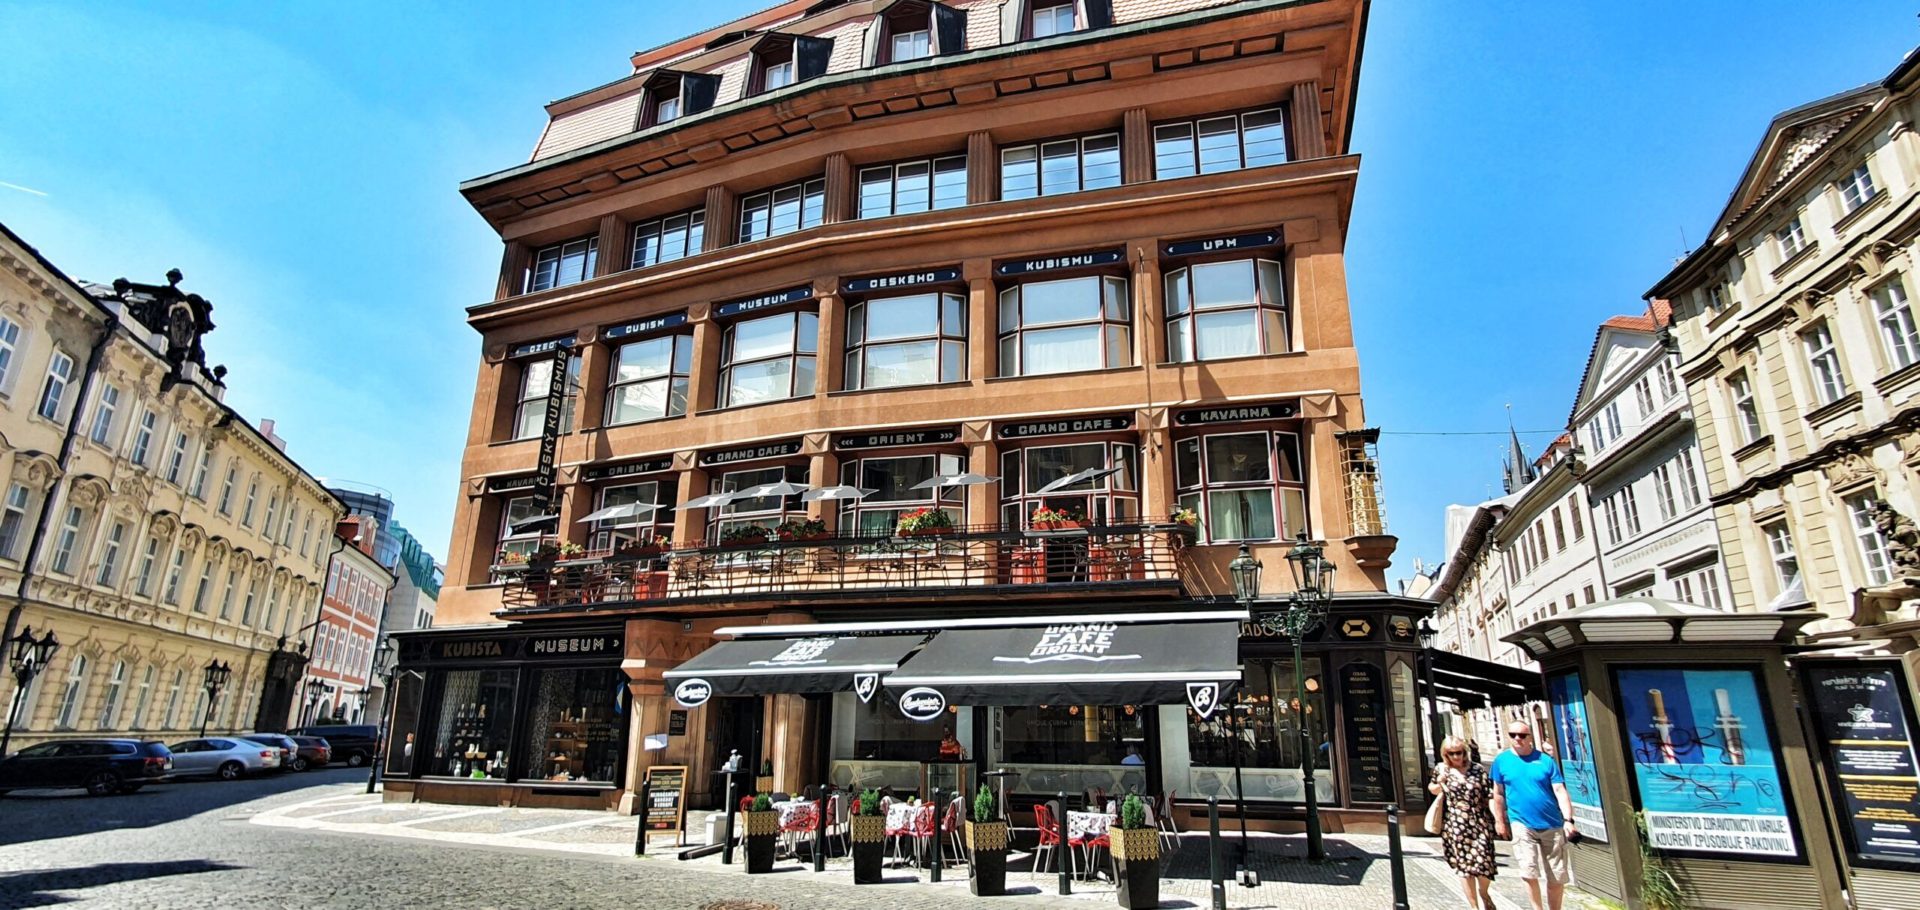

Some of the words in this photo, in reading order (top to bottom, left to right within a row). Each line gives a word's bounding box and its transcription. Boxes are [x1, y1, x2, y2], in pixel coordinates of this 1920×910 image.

[1202, 238, 1237, 250] UPM
[1026, 255, 1093, 271] KUBISMU
[738, 294, 788, 311] MUSEUM
[625, 319, 665, 334] CUBISM
[549, 350, 567, 429] KUBISMUS
[1200, 407, 1271, 421] KAVARNA
[1018, 422, 1067, 435] GRAND
[1073, 418, 1113, 432] CAFE
[868, 433, 925, 446] ORIENT
[717, 449, 754, 463] GRAND
[757, 445, 788, 459] CAFE
[608, 462, 651, 475] ORIENT
[534, 637, 605, 653] MUSEUM
[1036, 631, 1114, 647] CAFE
[443, 641, 502, 657] KUBISTA
[1030, 643, 1111, 656] ORIENT
[1651, 816, 1702, 830] MINISTERSTVO
[1703, 817, 1757, 833] ZDRAVOTNICTVÍ
[1655, 832, 1692, 847] KOUŘENÍ
[1694, 832, 1743, 850] ZPŮSOBUJE
